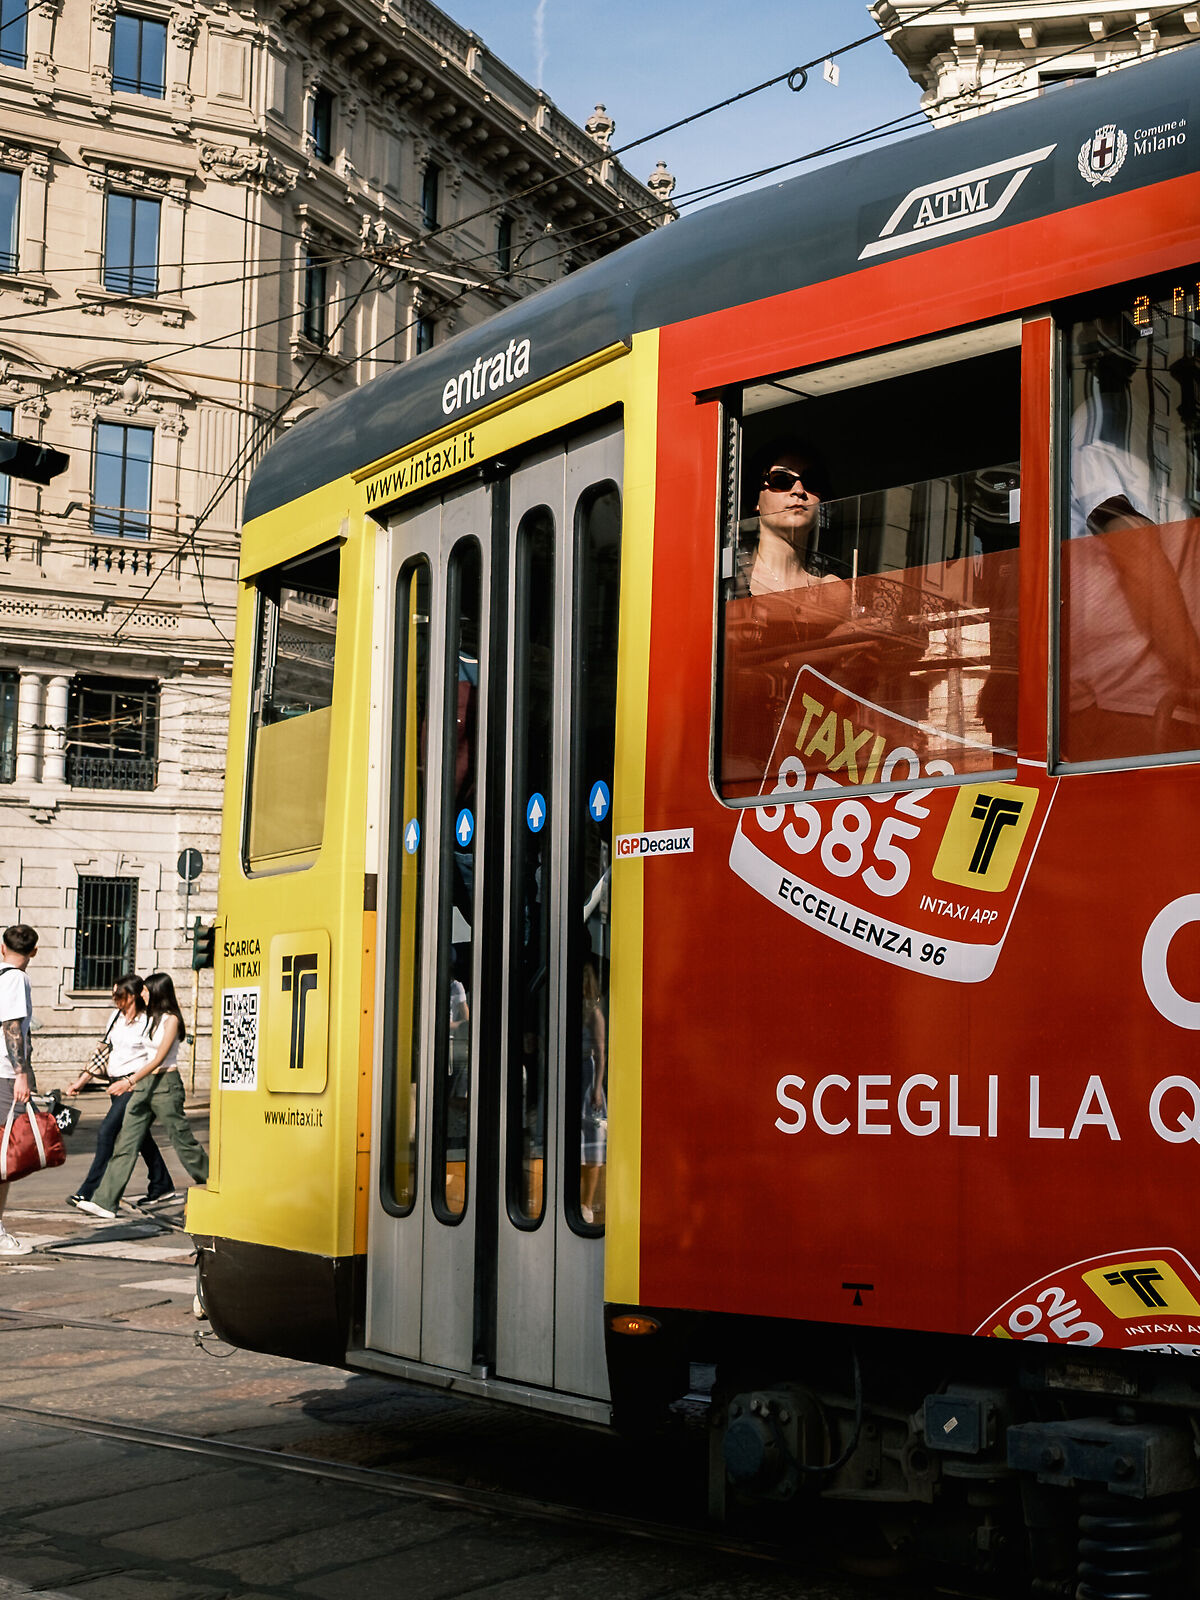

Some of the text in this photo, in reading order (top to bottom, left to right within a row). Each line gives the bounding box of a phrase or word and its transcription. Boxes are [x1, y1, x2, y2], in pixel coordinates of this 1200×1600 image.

[1133, 119, 1177, 141] Comune
[1133, 130, 1187, 157] Milano
[913, 179, 990, 229] ATM
[1134, 295, 1150, 326] 2
[442, 338, 531, 415] entrata
[366, 432, 476, 504] www.intaxi.it
[755, 755, 922, 897] 8585
[617, 837, 691, 855] IGPDecaux
[777, 877, 948, 966] ECCELLENZA 96
[919, 895, 999, 925] INTAXI APP
[224, 939, 261, 957] SCARICA
[233, 961, 261, 978] INTAXI
[264, 1107, 323, 1128] www.intaxi.it
[775, 1074, 999, 1139] SCEGLI
[1029, 1075, 1121, 1140] LA
[1125, 1323, 1183, 1337] INTAXI
